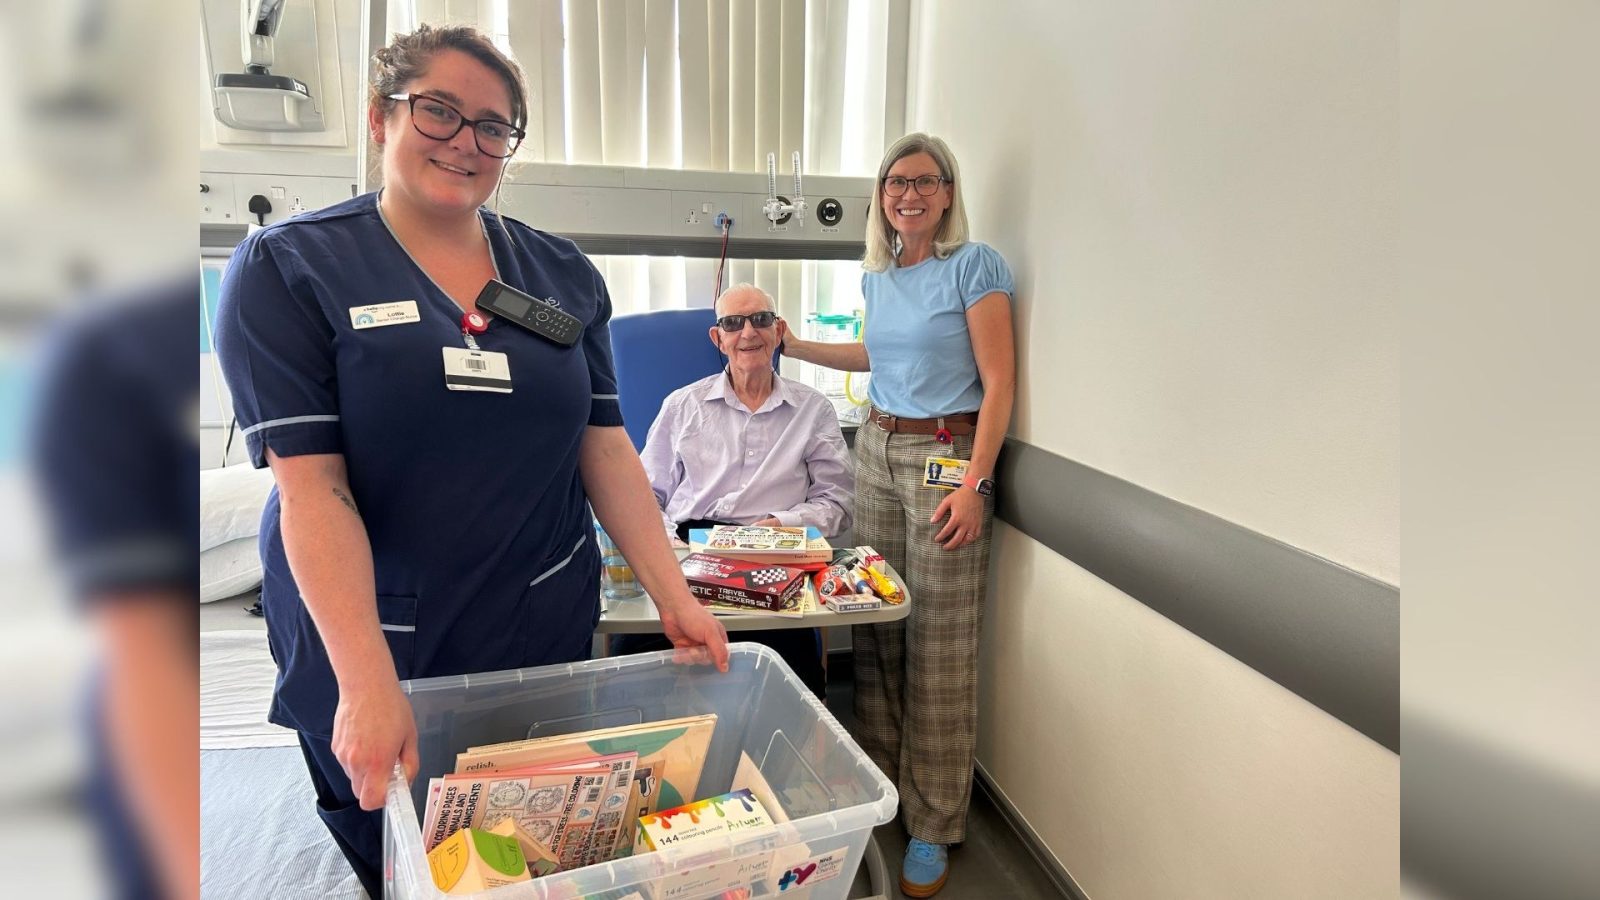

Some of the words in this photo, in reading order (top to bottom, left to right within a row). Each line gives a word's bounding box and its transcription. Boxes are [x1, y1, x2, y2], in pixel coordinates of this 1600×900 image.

[717, 593, 756, 606] CHECKERS
[756, 600, 772, 609] SET
[456, 793, 468, 808] AND
[434, 809, 451, 841] COLORING
[443, 786, 458, 809] PAGES
[659, 834, 680, 846] 144
